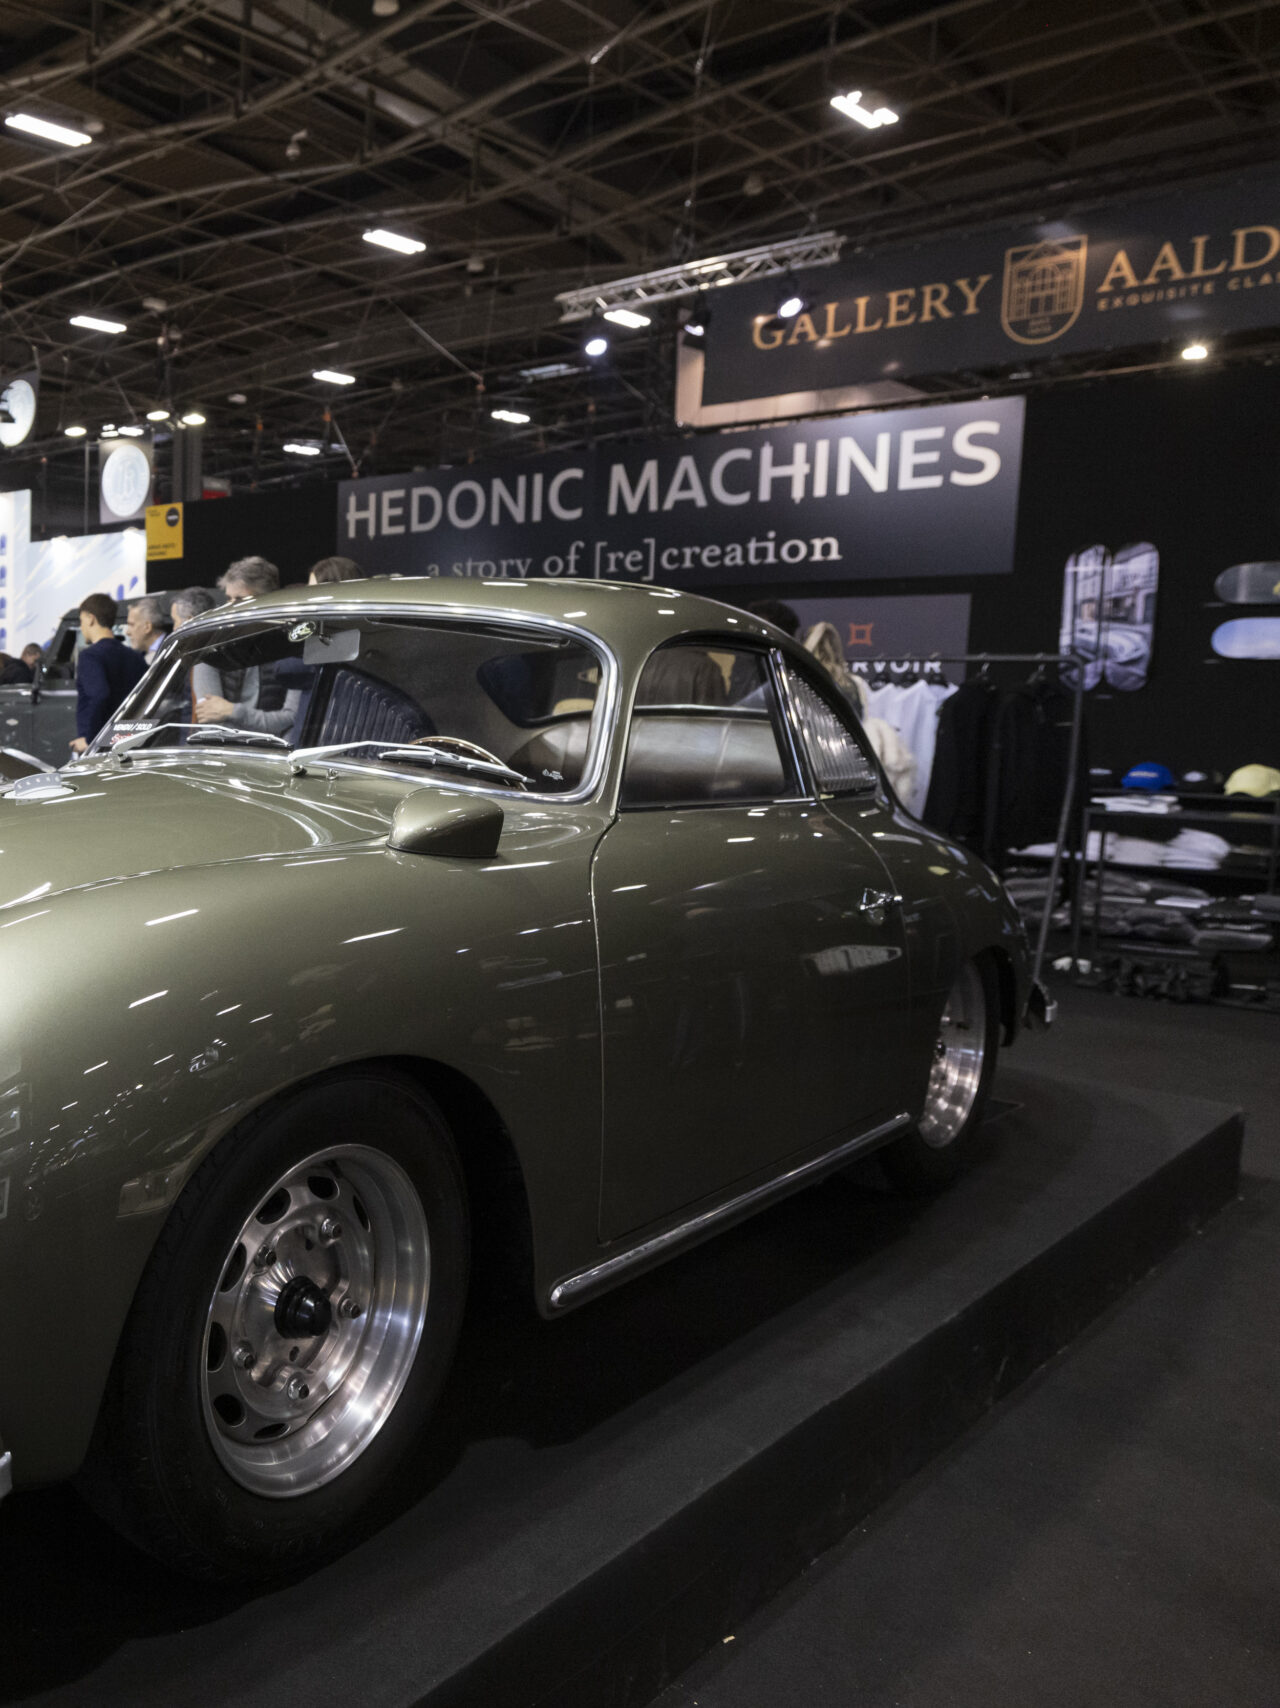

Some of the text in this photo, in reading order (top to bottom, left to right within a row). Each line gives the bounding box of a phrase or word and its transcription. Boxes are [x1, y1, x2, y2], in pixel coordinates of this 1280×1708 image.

[752, 274, 992, 350] GALLERY
[346, 420, 1002, 540] HEDONIC MACHINES
[453, 557, 532, 578] story
[543, 540, 585, 577] of
[595, 531, 842, 582] [re]creation
